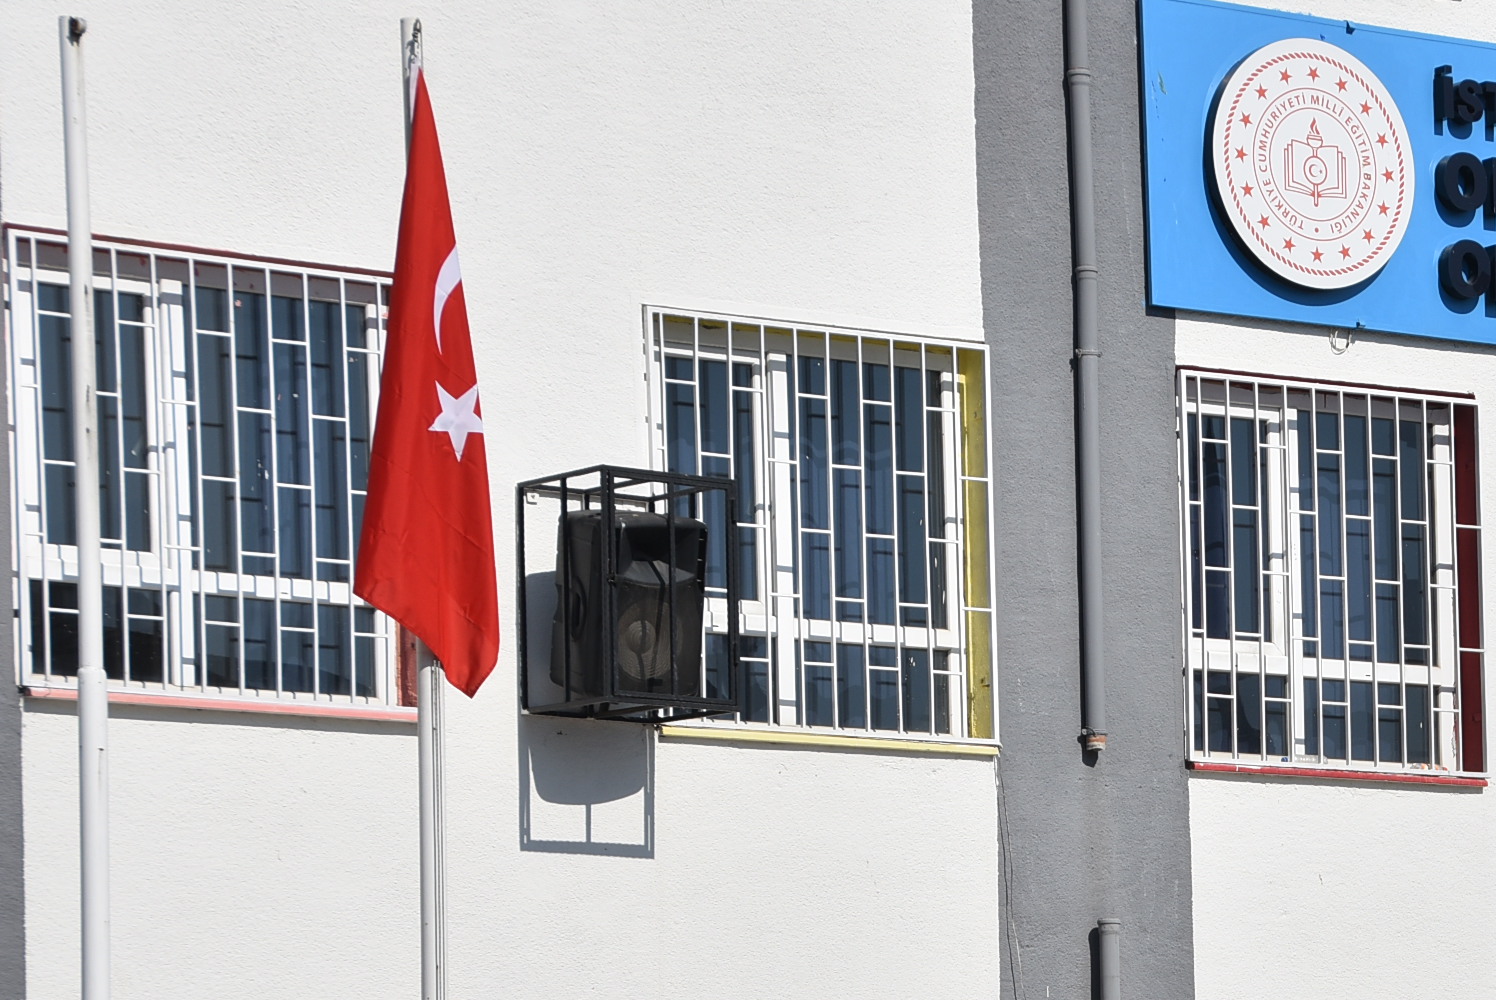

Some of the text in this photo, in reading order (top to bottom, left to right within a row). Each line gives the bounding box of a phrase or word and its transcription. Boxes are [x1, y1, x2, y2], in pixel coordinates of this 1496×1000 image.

[1256, 91, 1306, 173] CUMHURİYETİ
[1344, 116, 1371, 166] EĞİTİM
[1262, 178, 1304, 231] TÜRKİYE
[1329, 172, 1372, 234] BAKANLIĞI
